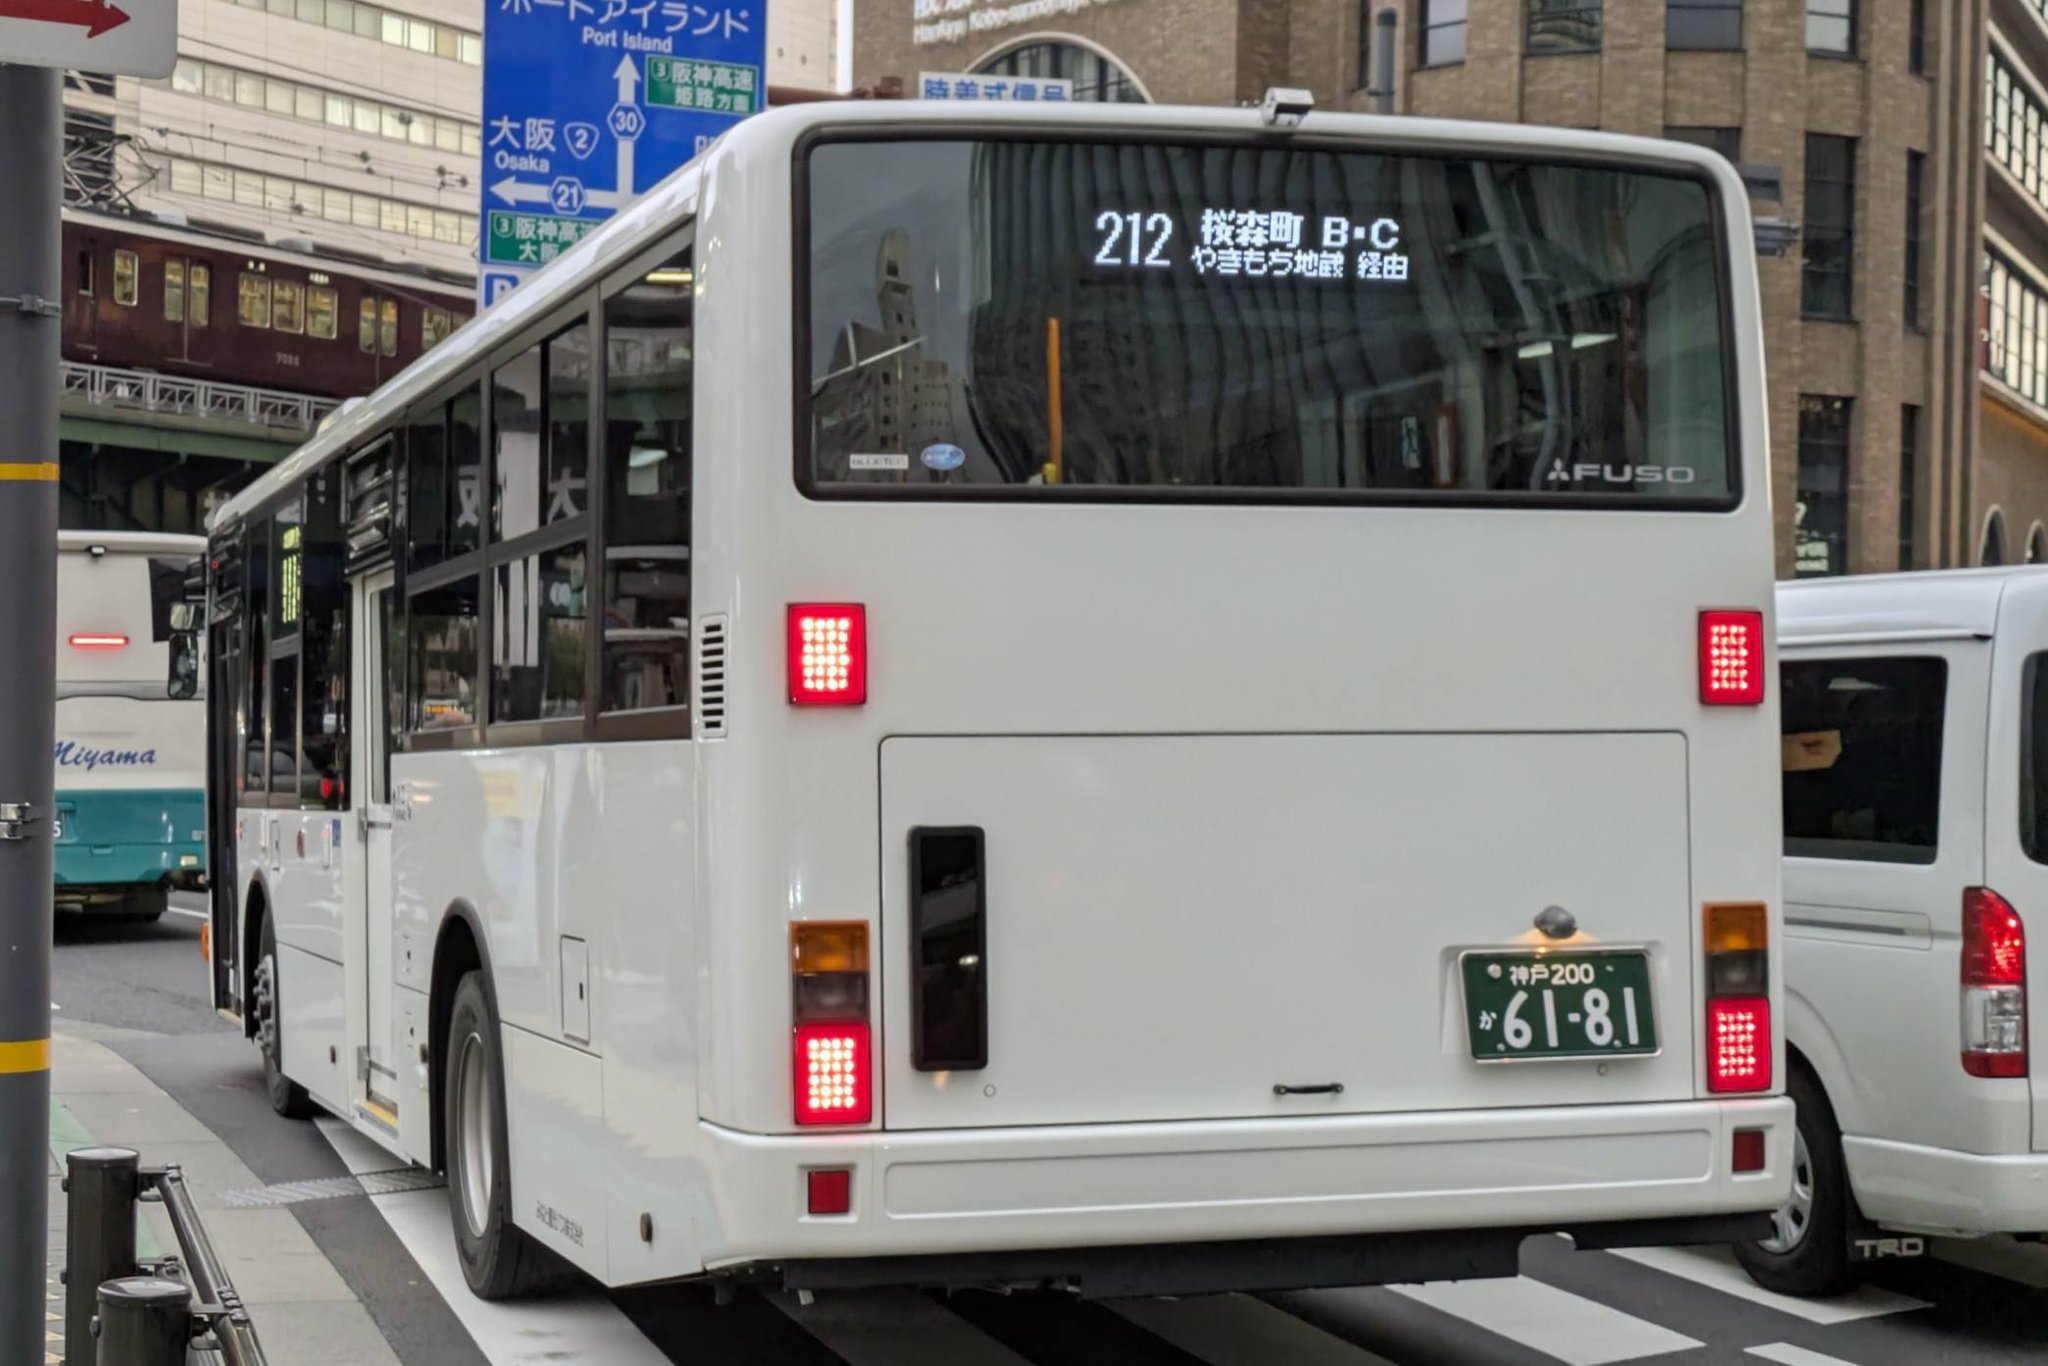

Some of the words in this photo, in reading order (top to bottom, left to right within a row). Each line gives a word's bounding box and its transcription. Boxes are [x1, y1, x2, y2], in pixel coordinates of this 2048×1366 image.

[582, 25, 617, 48] Port
[623, 30, 673, 53] Island
[672, 61, 753, 92] 阪神高速
[488, 115, 556, 152] 大阪
[615, 110, 638, 132] 30
[575, 128, 588, 149] 2
[494, 150, 550, 173] Osaka
[557, 184, 579, 208] 21
[1094, 210, 1173, 267] 212
[1201, 207, 1304, 249] 桜森町
[1190, 244, 1344, 278] やきもち地蔵
[1357, 250, 1408, 281] 経由
[1573, 463, 1695, 483] FUSO
[54, 741, 156, 771] Miyama
[1503, 986, 1640, 1049] 61-81
[1854, 1237, 1924, 1258] TRD
